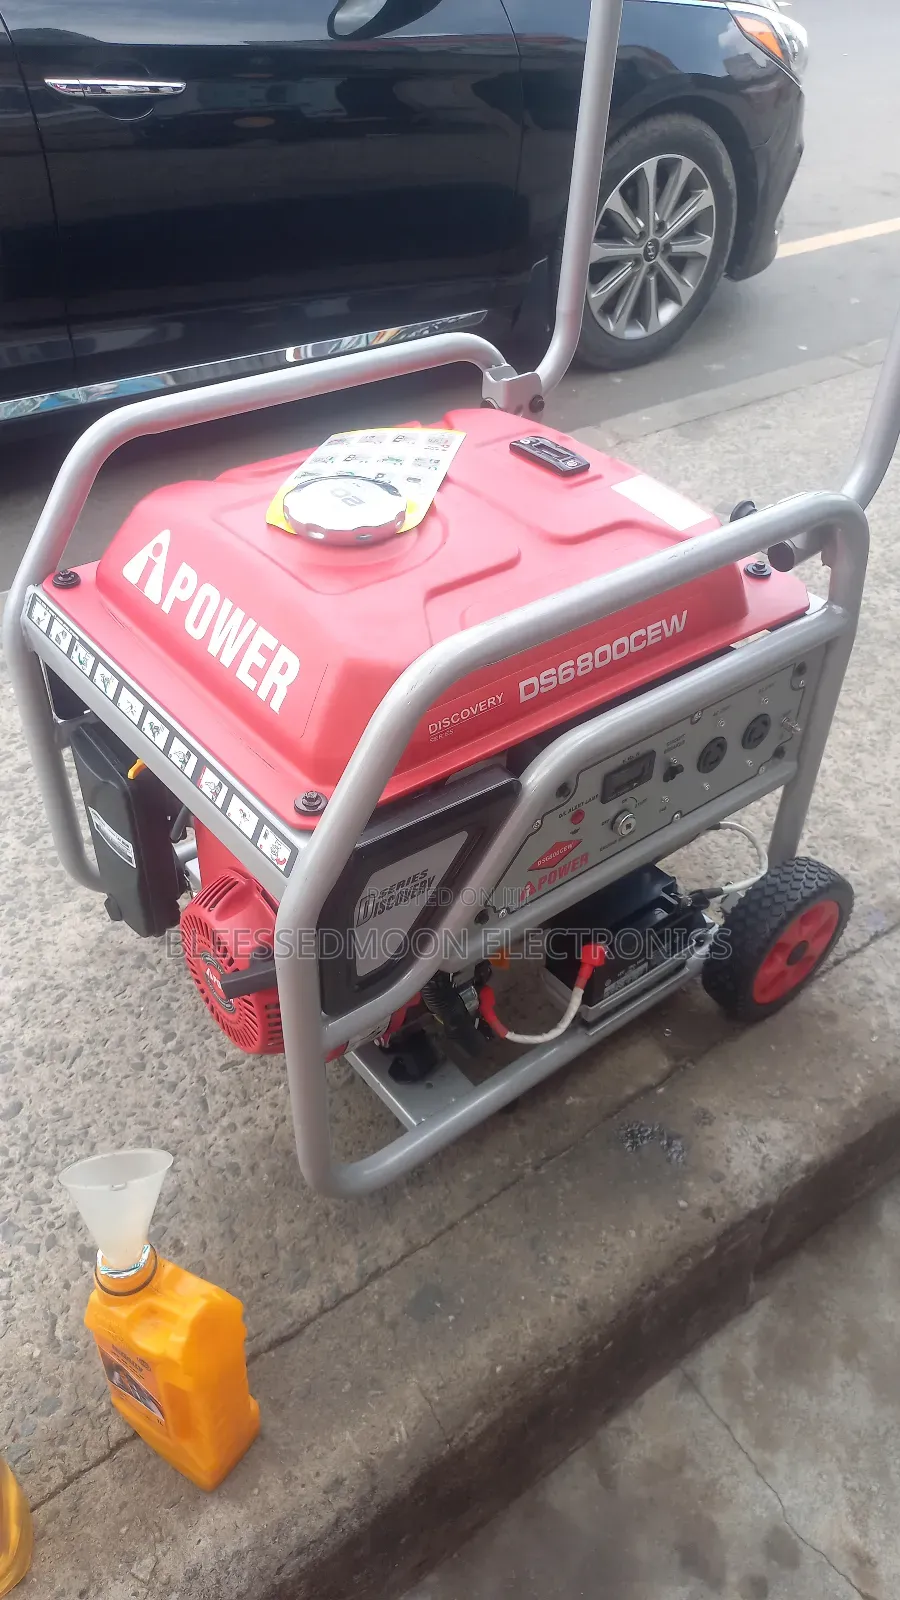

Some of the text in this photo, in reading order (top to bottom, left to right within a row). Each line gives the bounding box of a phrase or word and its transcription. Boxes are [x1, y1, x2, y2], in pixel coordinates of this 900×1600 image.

[518, 610, 688, 704] DS6800CEW
[428, 692, 504, 735] DISCOVERY
[355, 875, 436, 928] DISCOVERY
[378, 869, 429, 899] SERIES
